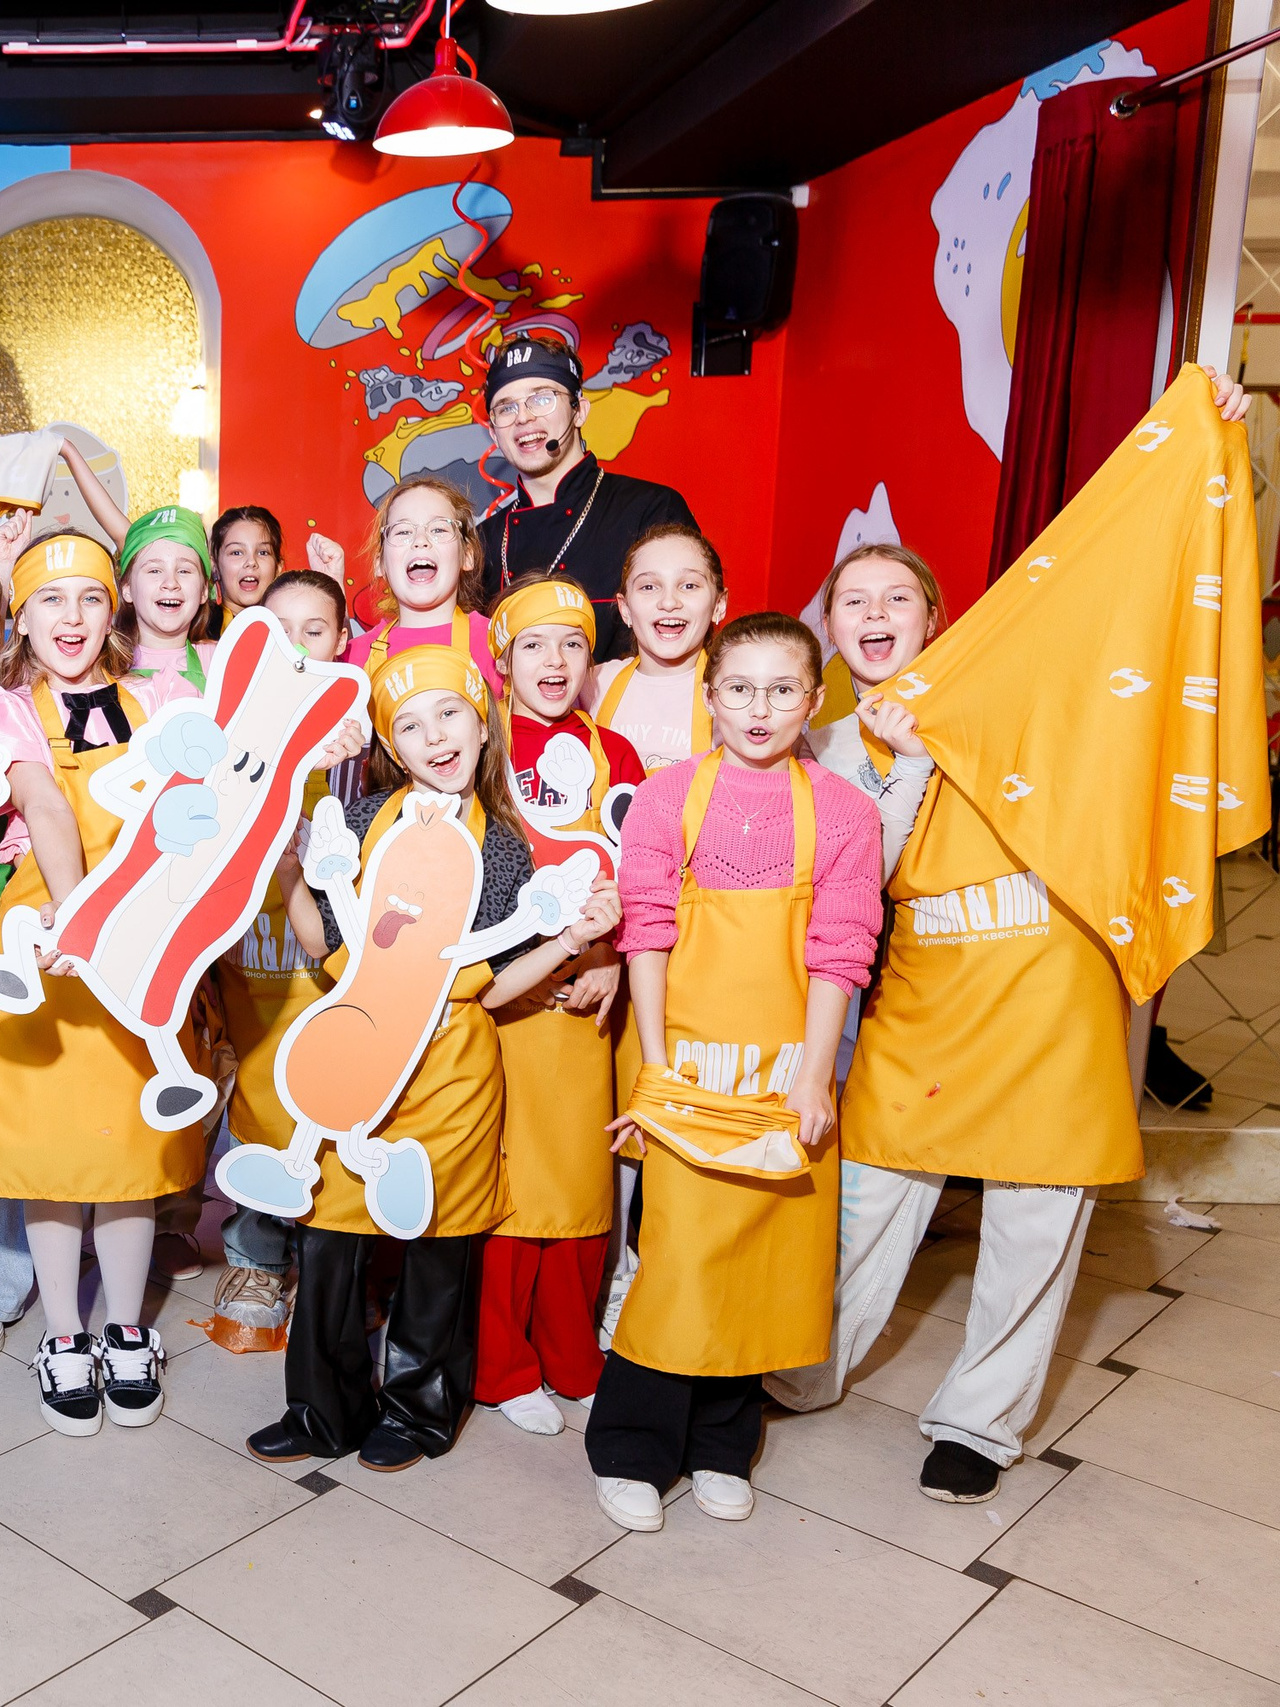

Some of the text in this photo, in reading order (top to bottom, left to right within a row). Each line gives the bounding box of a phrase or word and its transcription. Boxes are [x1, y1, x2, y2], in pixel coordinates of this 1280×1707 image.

[506, 346, 532, 367] C&R
[384, 663, 415, 702] C&R
[1181, 675, 1219, 715] C&R
[1169, 773, 1210, 813] C&R
[257, 912, 280, 972] &
[917, 926, 1050, 948] кулинарное квест-шоу
[269, 970, 320, 980] квест-шоу
[737, 1043, 761, 1097] &
